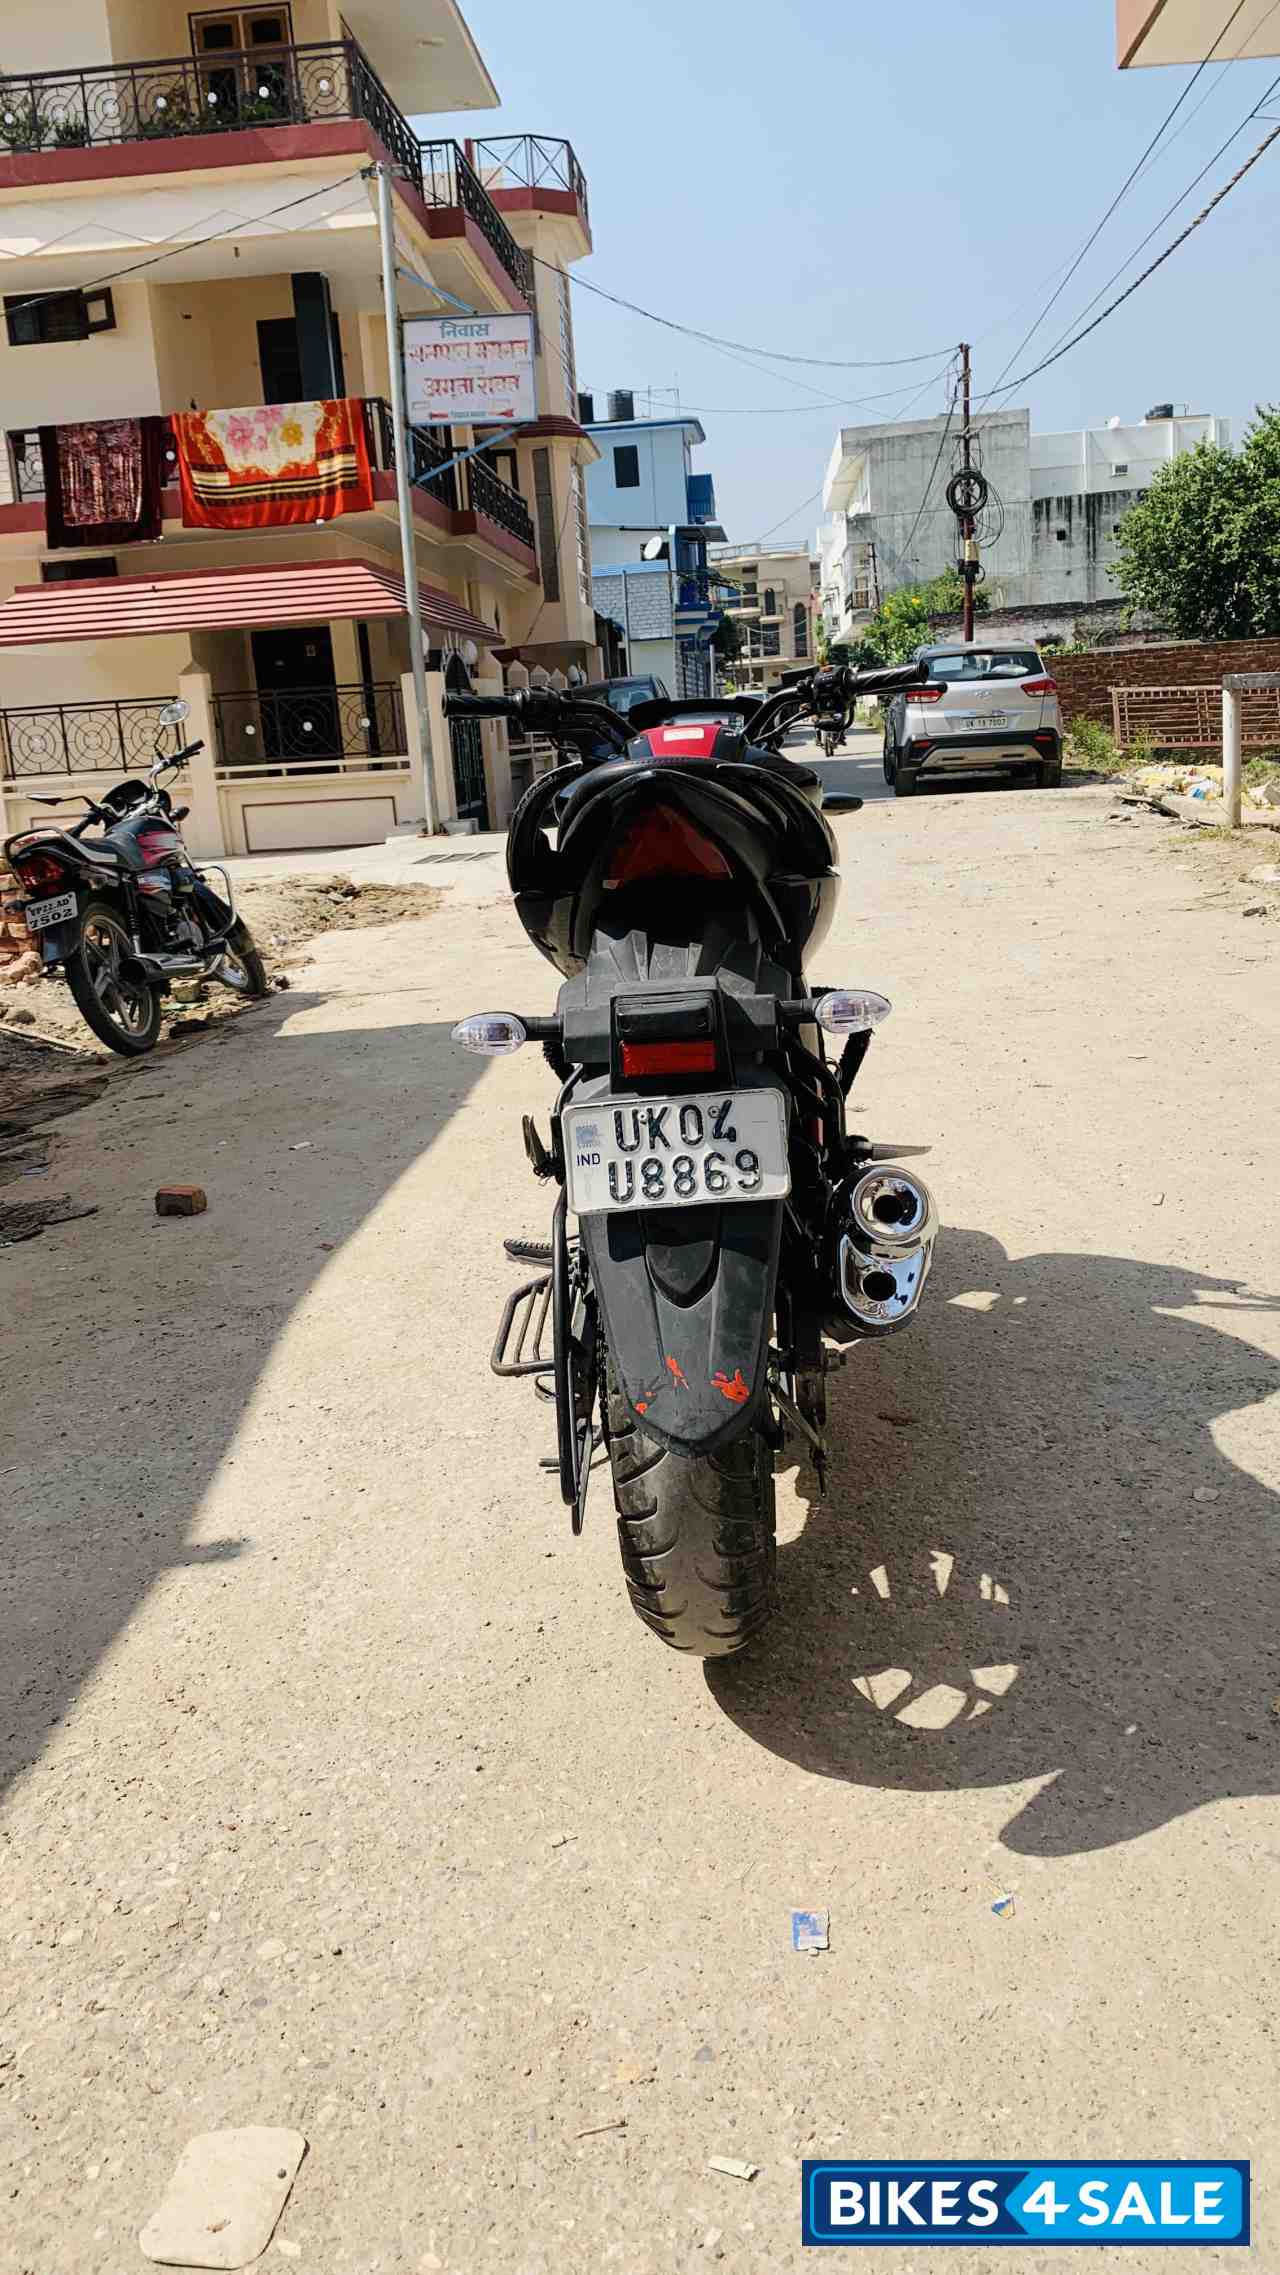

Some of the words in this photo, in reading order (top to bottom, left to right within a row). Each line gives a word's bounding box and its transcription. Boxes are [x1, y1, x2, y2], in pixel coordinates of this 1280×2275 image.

[440, 320, 489, 338] निवास
[30, 908, 72, 928] 7502
[613, 1099, 737, 1152] UK04
[576, 1152, 601, 1167] IND
[607, 1149, 761, 1202] U8869
